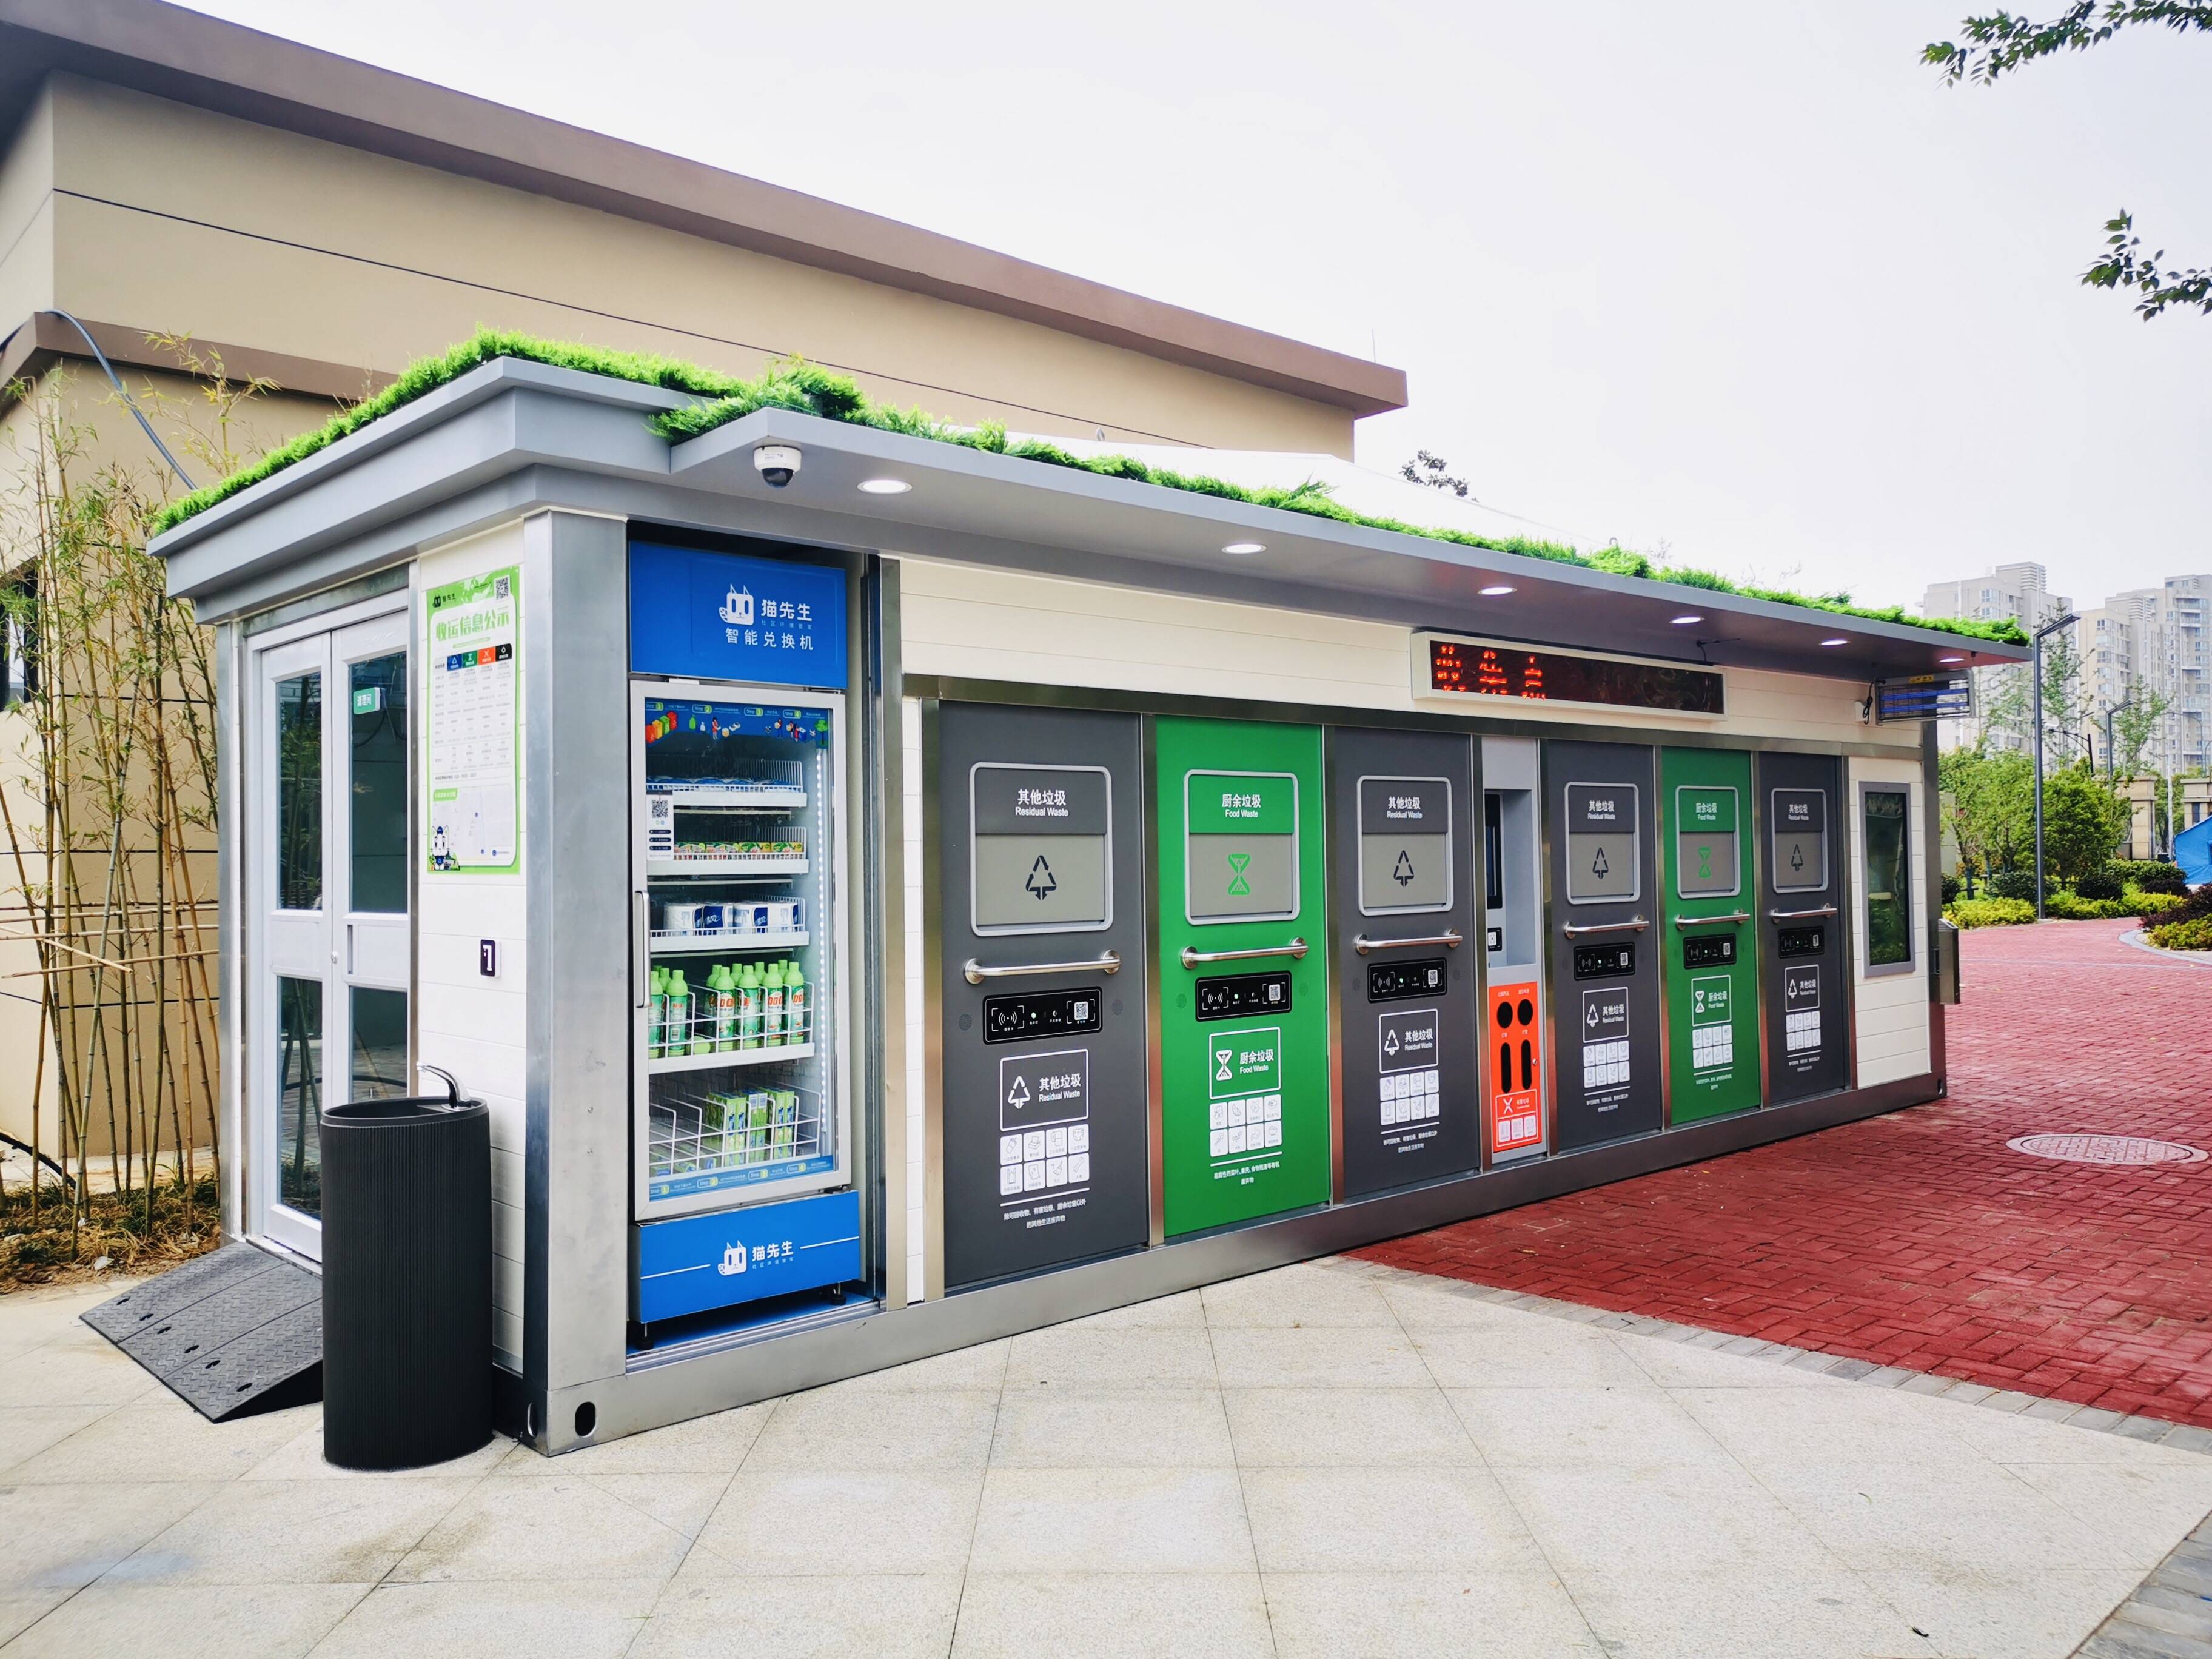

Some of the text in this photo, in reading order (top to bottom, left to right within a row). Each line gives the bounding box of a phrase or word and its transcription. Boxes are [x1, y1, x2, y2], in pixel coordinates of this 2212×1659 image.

[761, 599, 812, 622] 猫先生
[436, 609, 509, 641] 收运信息公示
[726, 627, 813, 650] 智能兑换机
[1017, 789, 1067, 806] 其他垃圾
[1222, 794, 1261, 808] 厨余垃圾
[1388, 796, 1421, 809] 其他垃圾
[1015, 806, 1068, 817] Residual Waste
[1404, 1028, 1433, 1043] 其他垃圾
[1239, 1049, 1274, 1065] 厨余垃圾
[1039, 1073, 1081, 1091] 其他垃圾
[1039, 1090, 1081, 1102] Residual Waste
[752, 1241, 794, 1261] 猫先生
